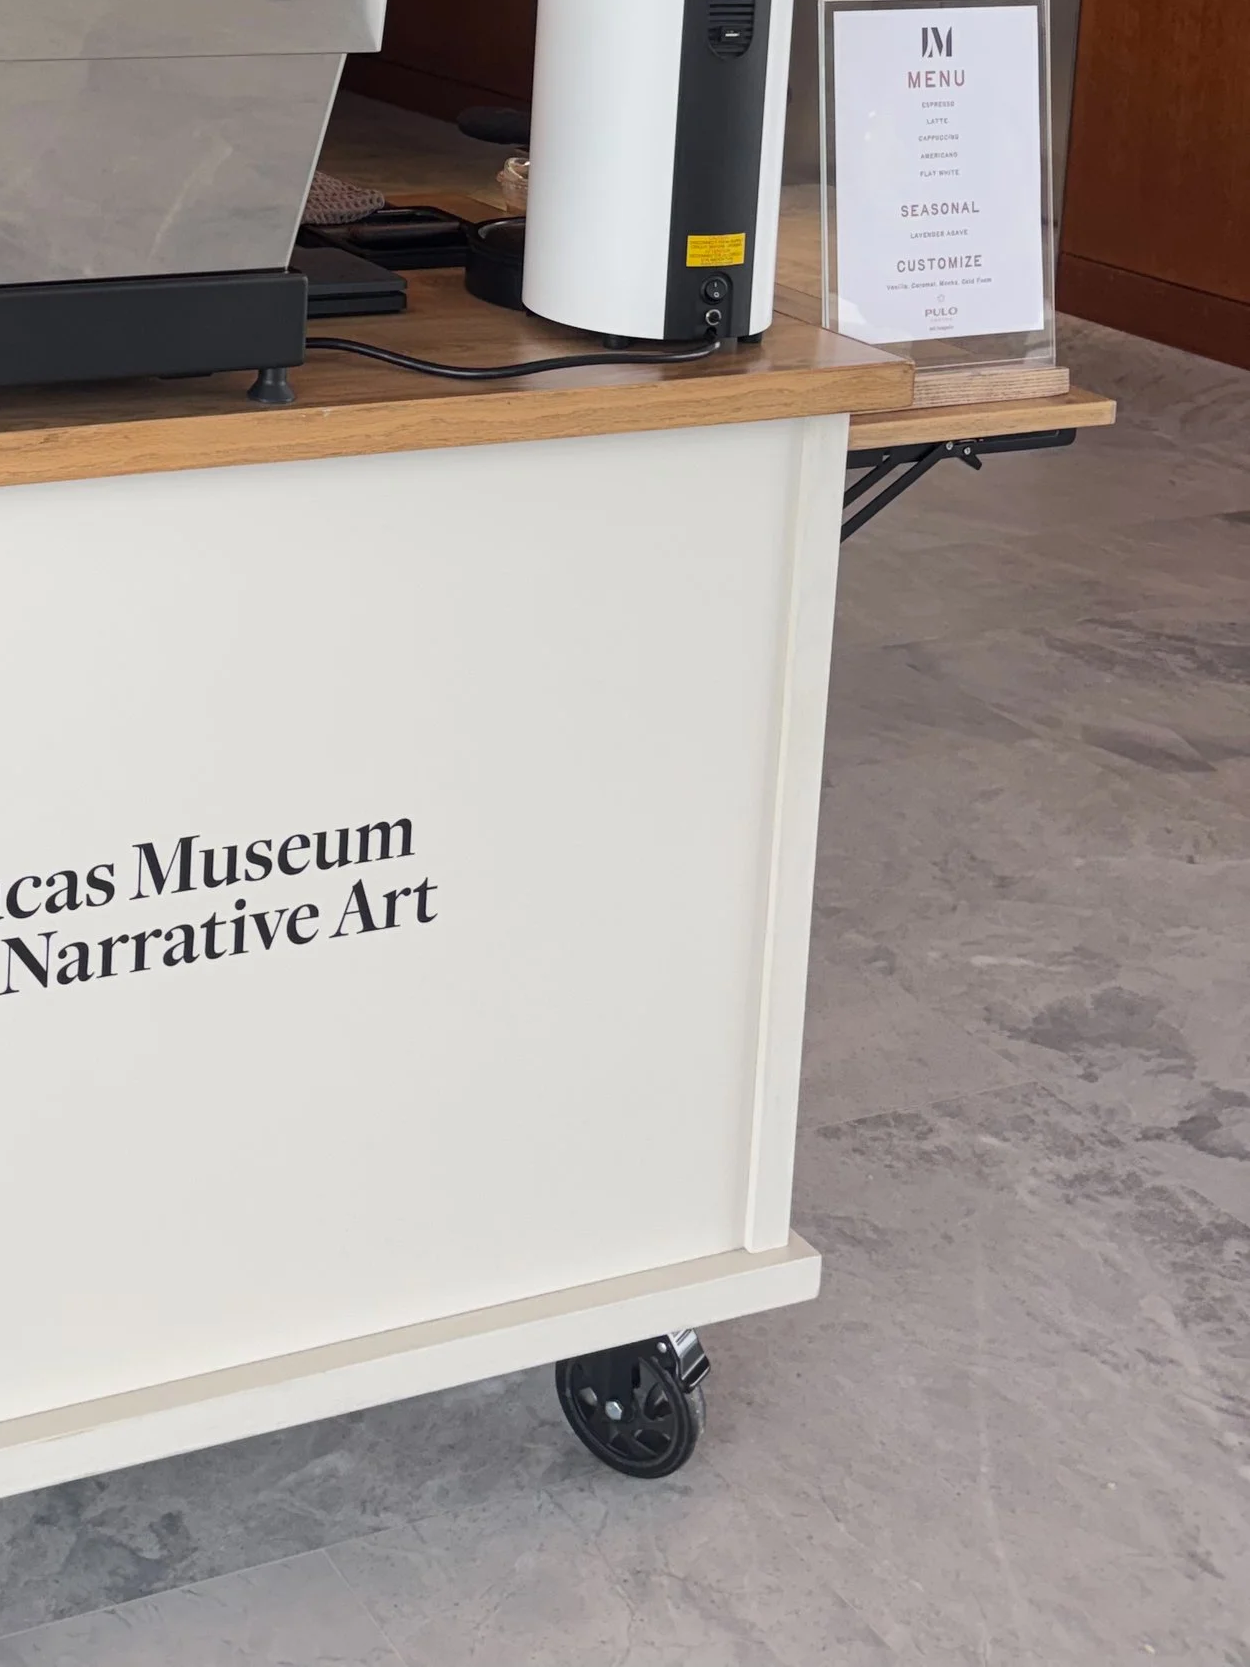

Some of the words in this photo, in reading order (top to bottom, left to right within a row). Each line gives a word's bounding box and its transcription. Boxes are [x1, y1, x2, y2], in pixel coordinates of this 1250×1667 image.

[908, 69, 965, 89] MENU
[921, 101, 955, 109] ESPRESSO
[900, 201, 980, 217] SEASONAL
[910, 230, 945, 239] LAVENDER
[896, 254, 982, 273] CUSTOMIZE
[924, 306, 958, 317] PULO
[129, 818, 415, 901] Museum
[0, 898, 319, 996] Narrative
[329, 877, 438, 939] Art
